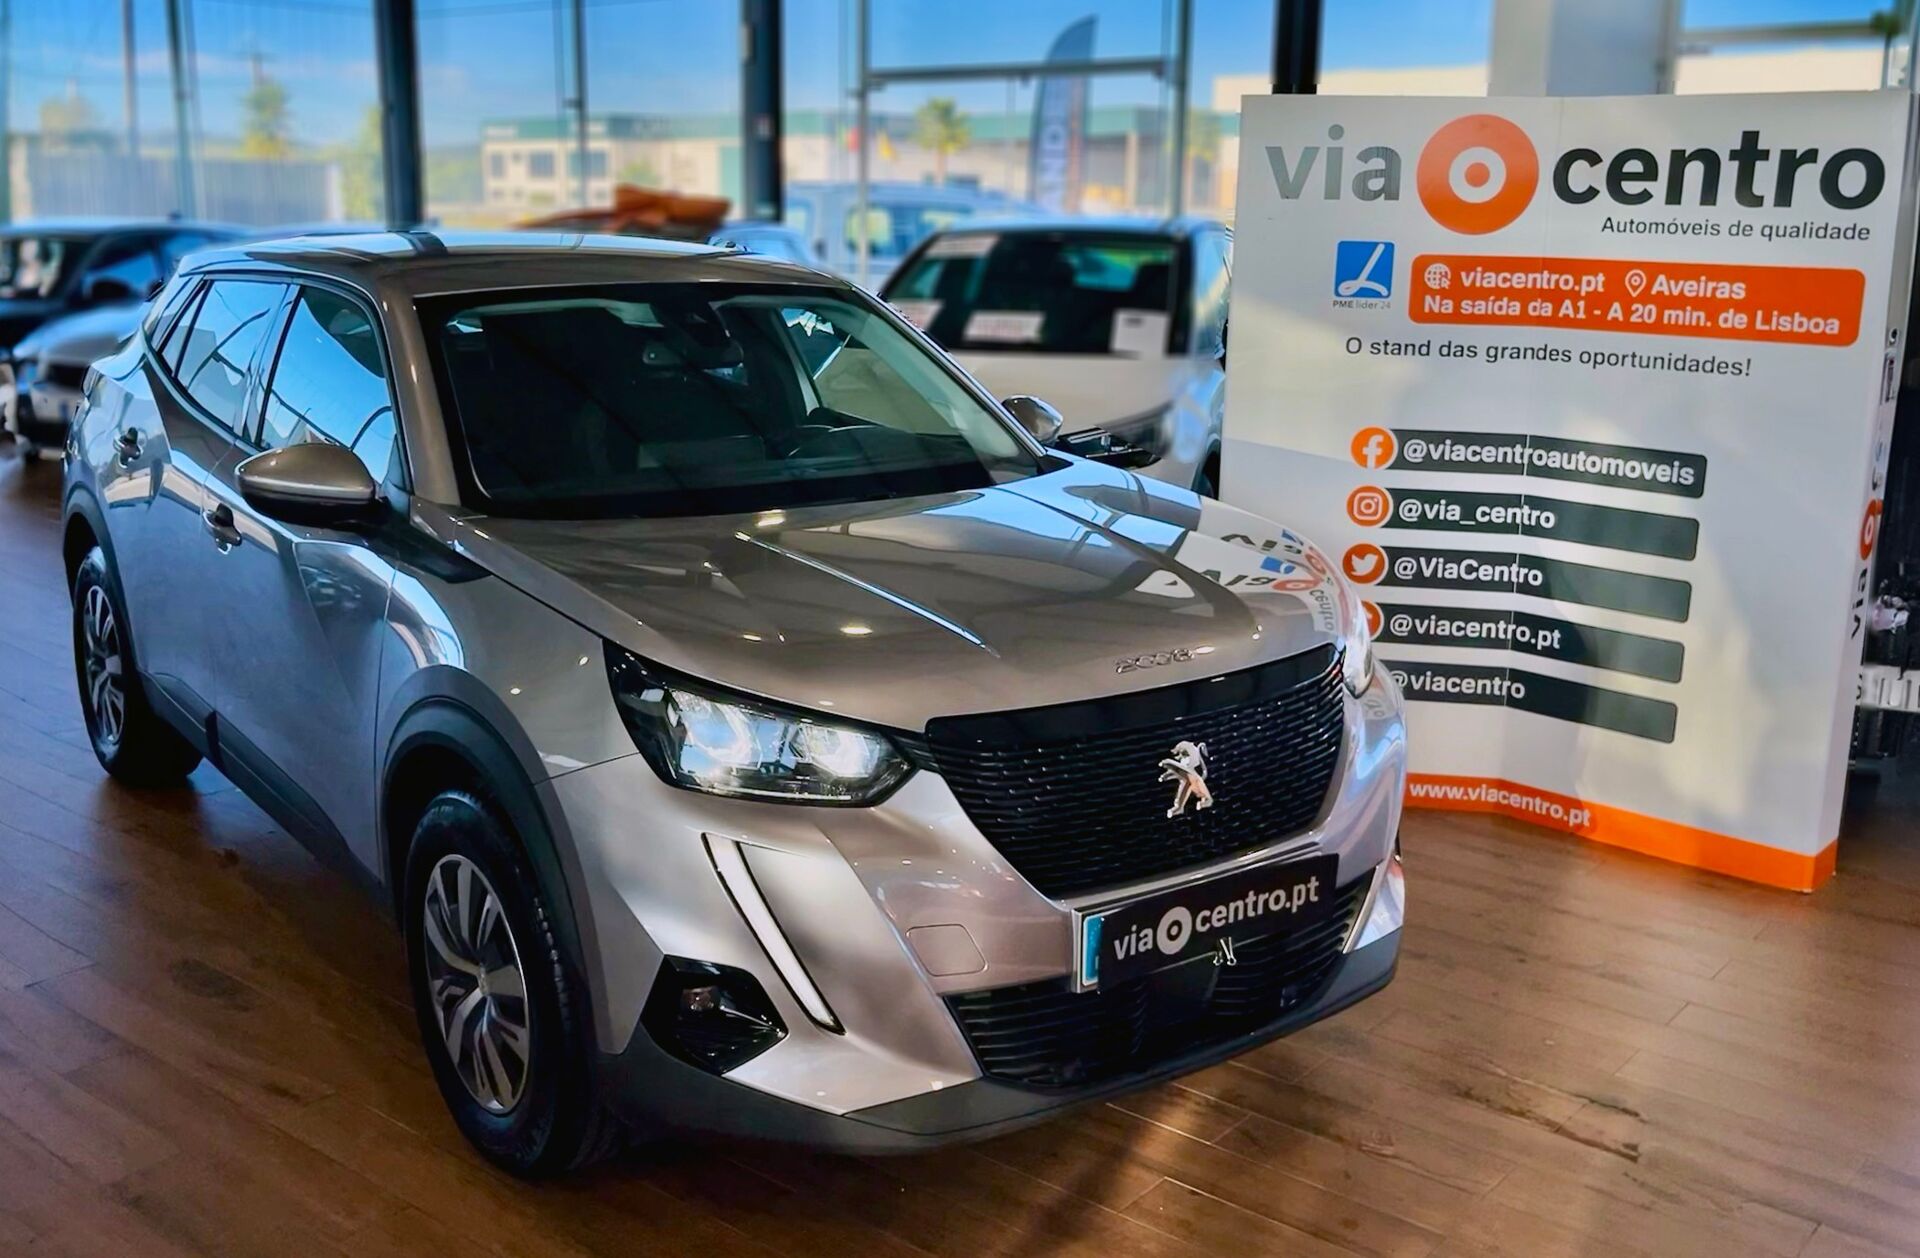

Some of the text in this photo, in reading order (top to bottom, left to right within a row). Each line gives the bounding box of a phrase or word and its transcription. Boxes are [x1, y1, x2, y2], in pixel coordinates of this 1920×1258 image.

[1265, 124, 1886, 210] via centro
[1601, 217, 1871, 242] Automóveis de qualidade
[1460, 267, 1605, 295] viacentro.pt
[1651, 274, 1747, 300] Aveiras
[1332, 300, 1353, 309] PME
[1424, 295, 1453, 314] Na
[1460, 296, 1521, 316] saída
[1528, 298, 1552, 317] da
[1558, 300, 1586, 319] A1
[1607, 302, 1624, 321] A
[1630, 304, 1657, 323] 20
[1663, 306, 1712, 328] min.
[1718, 309, 1748, 330] de
[1755, 310, 1840, 335] Lisboa
[1345, 337, 1752, 377] O stand das grandes oportunidades!
[1403, 439, 1695, 485] @viacentroautomoveis
[1398, 499, 1556, 528] @via_centro
[1394, 557, 1543, 585] @ViaCentro
[1390, 614, 1562, 650] @viacentro.pt
[1112, 648, 1196, 675] 2008
[1409, 782, 1592, 828] www.viacentro.pt
[1113, 875, 1320, 960] via centro.pt
